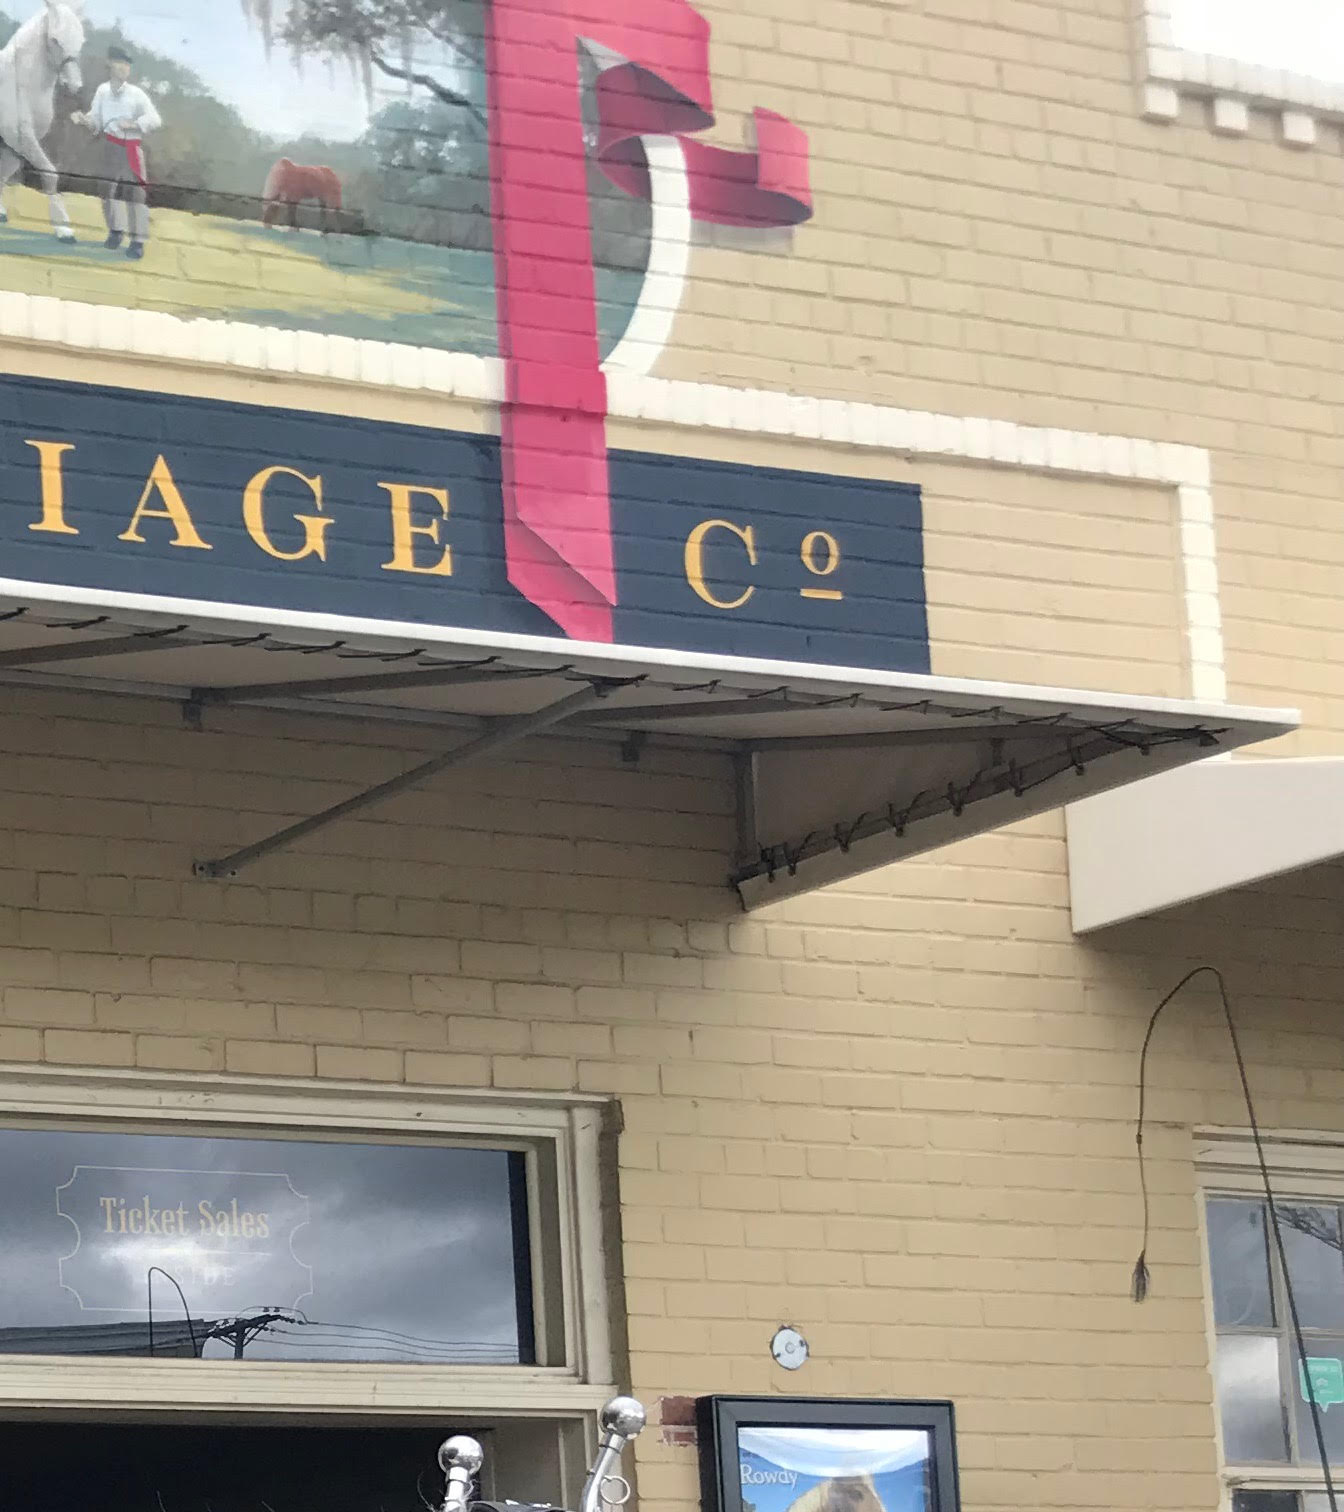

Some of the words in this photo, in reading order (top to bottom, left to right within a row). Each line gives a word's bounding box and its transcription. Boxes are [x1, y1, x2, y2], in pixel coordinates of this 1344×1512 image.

[100, 1195, 189, 1236] Ticket
[198, 1198, 270, 1239] Sales
[739, 1463, 798, 1490] Rowdy
